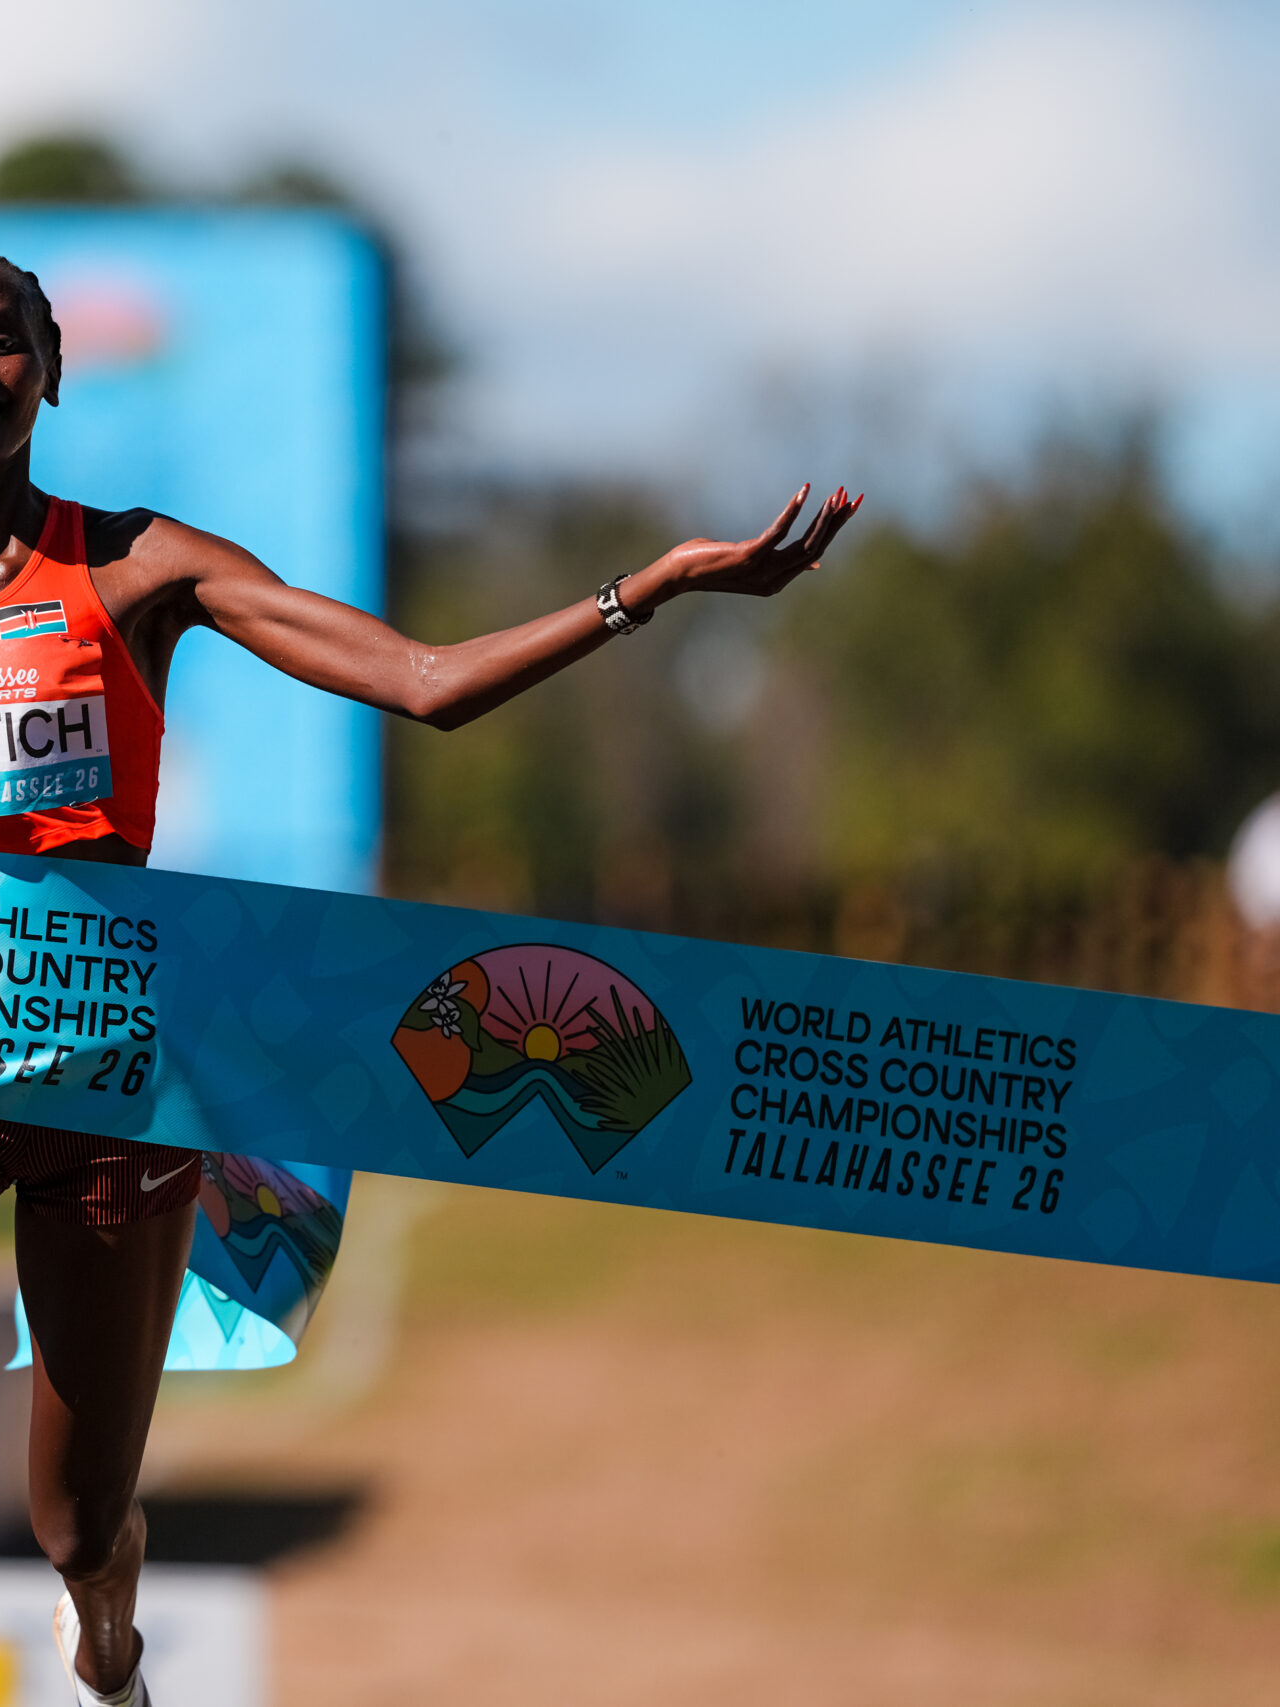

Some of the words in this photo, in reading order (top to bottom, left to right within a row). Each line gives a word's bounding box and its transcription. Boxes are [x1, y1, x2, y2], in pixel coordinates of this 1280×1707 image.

[75, 766, 99, 791] 26
[740, 997, 871, 1044] WORLD
[879, 1016, 1077, 1071] ATHLETICS
[88, 1048, 151, 1097] 26
[735, 1040, 869, 1089] CROSS
[880, 1058, 1072, 1114] COUNTRY
[730, 1084, 1067, 1159] CHAMPIONSHIPS
[724, 1128, 997, 1206] TALLAHASSEE
[1011, 1165, 1064, 1215] 26
